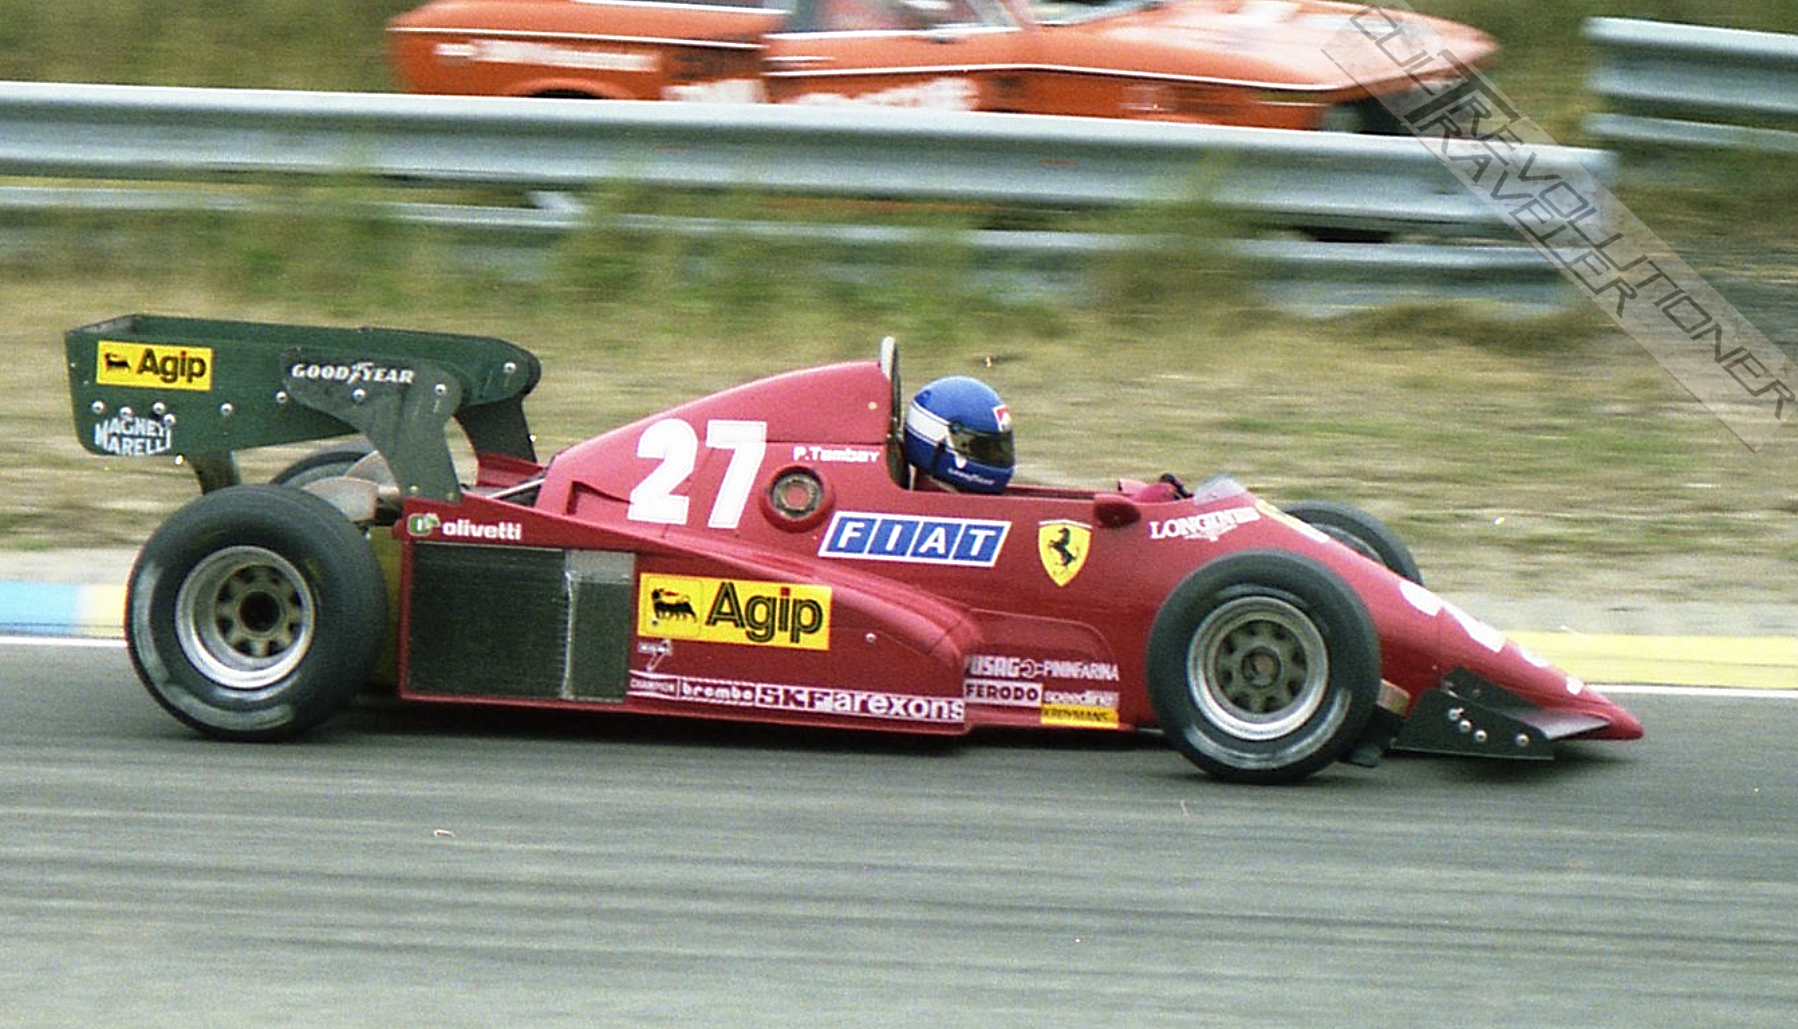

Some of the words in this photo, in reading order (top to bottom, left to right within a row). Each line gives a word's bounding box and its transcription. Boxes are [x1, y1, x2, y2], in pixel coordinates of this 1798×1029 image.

[136, 347, 207, 384] Agip
[291, 361, 415, 384] GOODYEAR
[627, 418, 767, 529] 27
[442, 518, 521, 540] olivetti
[837, 519, 997, 556] FIAT
[705, 581, 824, 643] Agip
[682, 681, 754, 701] brembo
[757, 684, 830, 709] SKF
[965, 682, 1040, 702] FERODO
[832, 691, 965, 721] arexons
